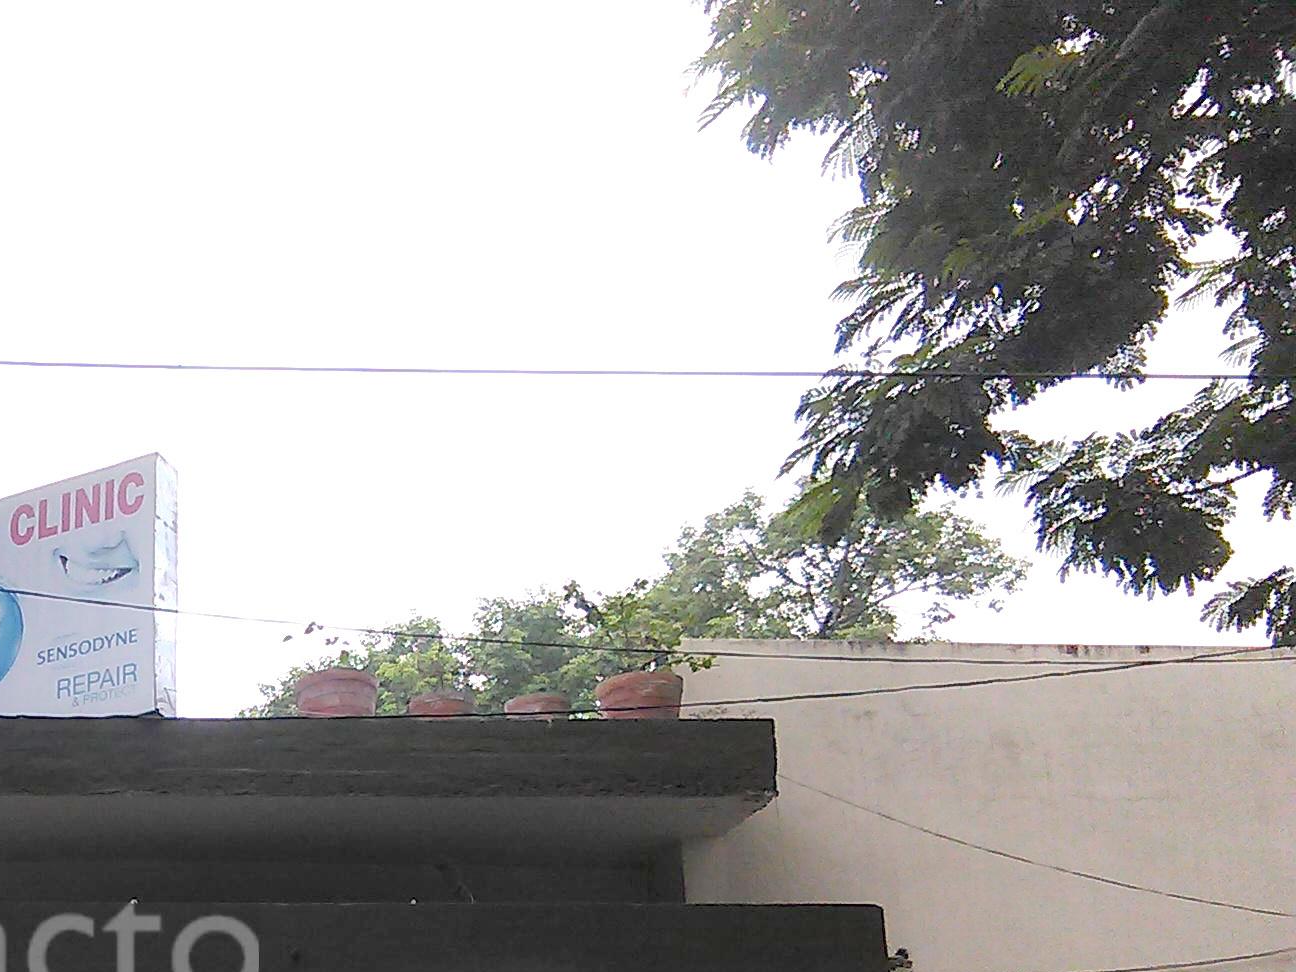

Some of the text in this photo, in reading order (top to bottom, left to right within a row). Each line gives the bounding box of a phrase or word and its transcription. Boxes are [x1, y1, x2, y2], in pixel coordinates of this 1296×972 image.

[10, 471, 145, 546] CLINIC
[36, 628, 138, 666] SENSODYNE
[56, 663, 138, 699] REPAIR
